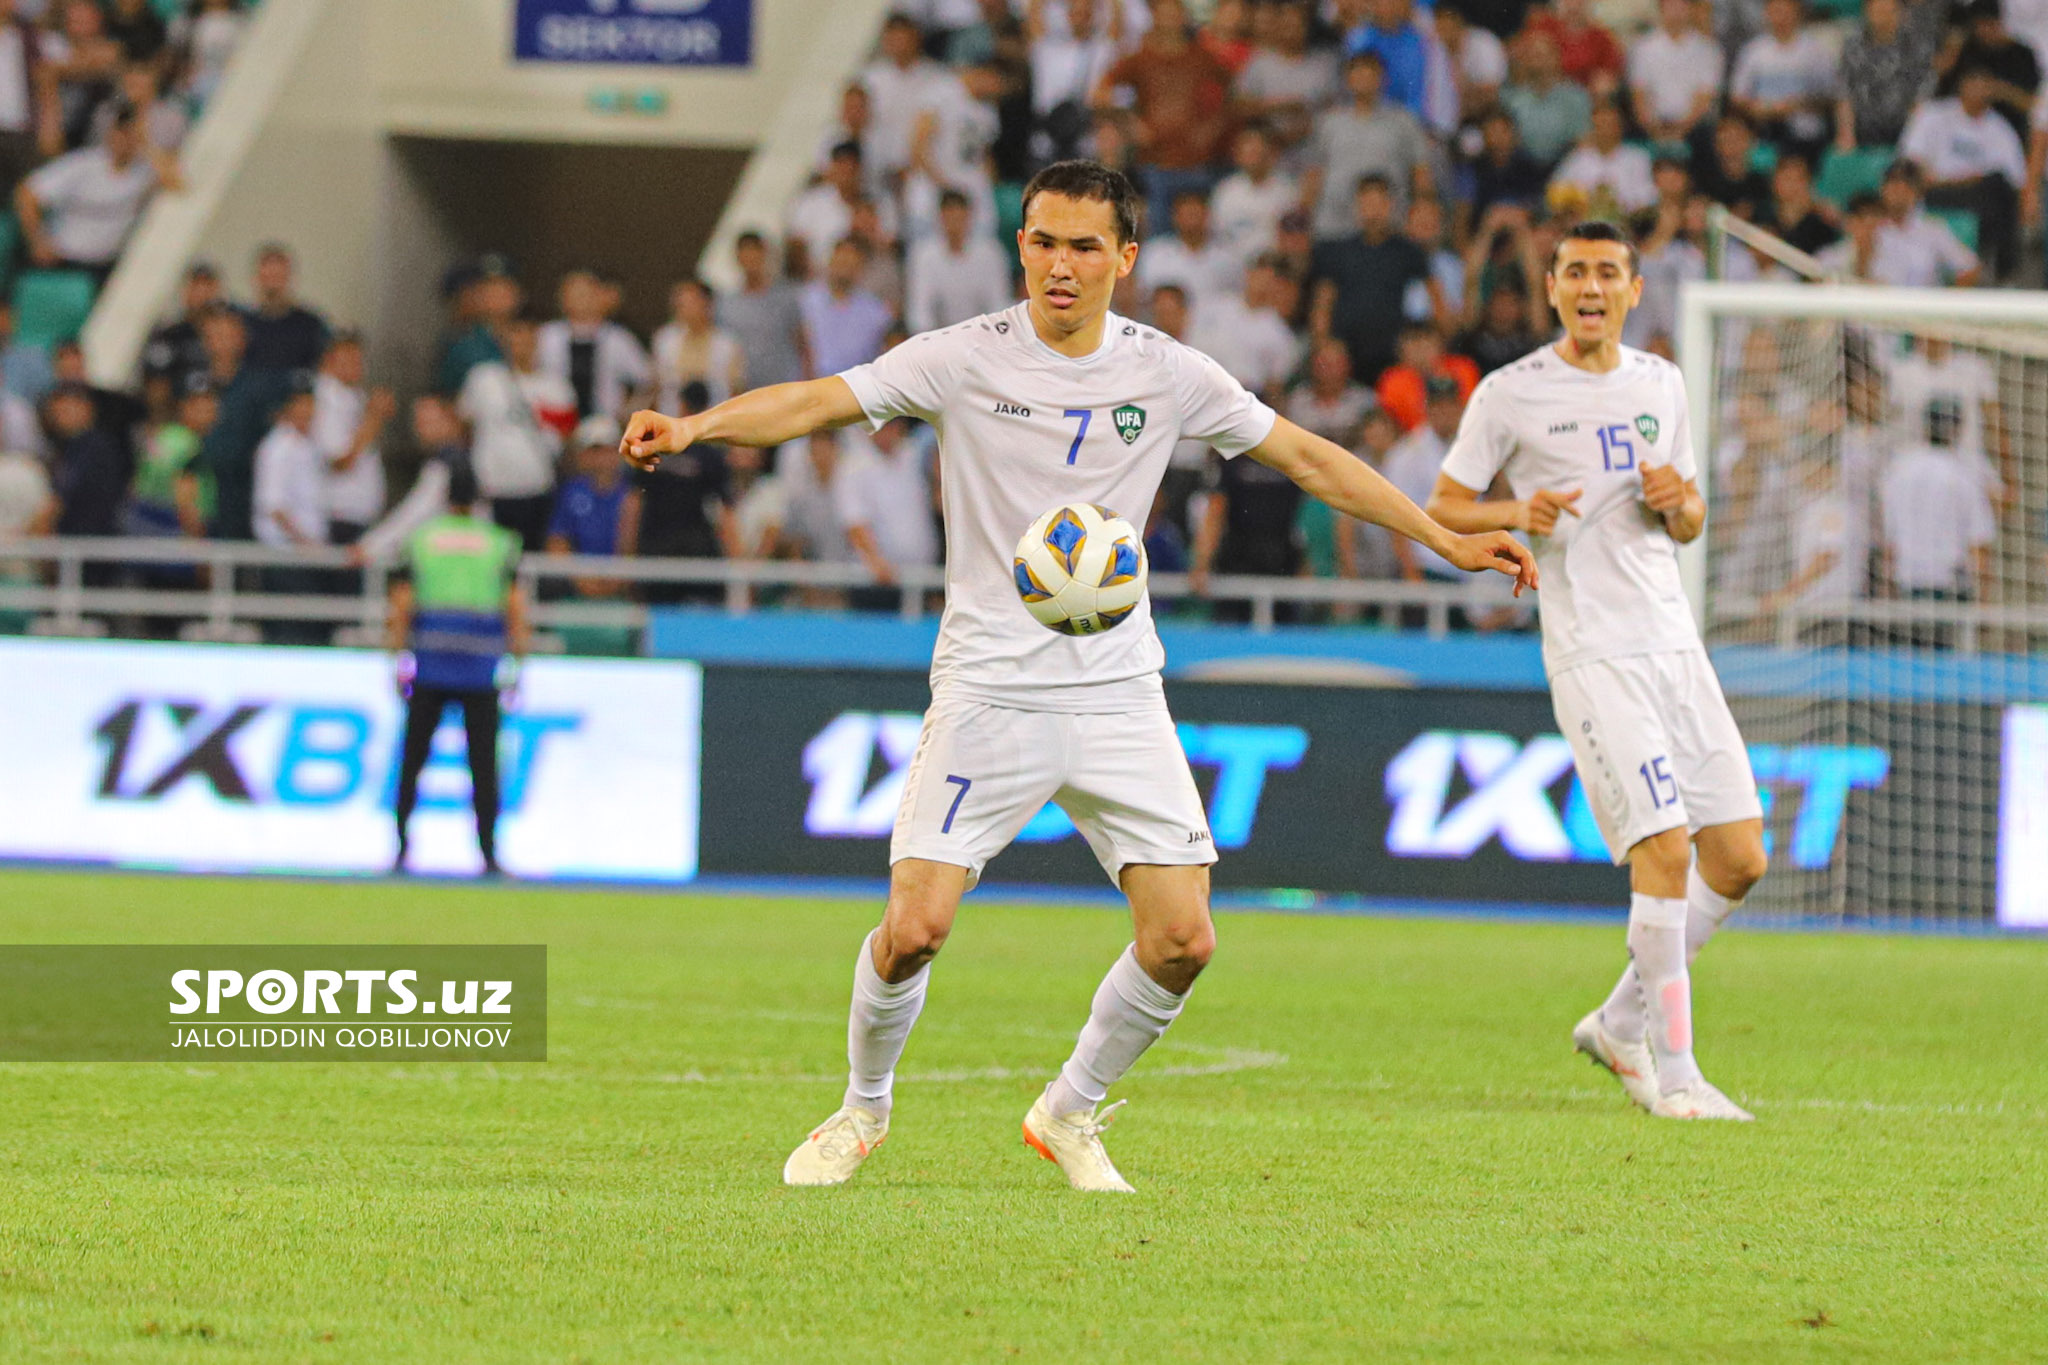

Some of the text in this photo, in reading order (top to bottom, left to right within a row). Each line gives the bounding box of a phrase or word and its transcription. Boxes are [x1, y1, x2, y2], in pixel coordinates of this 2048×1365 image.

[994, 402, 1031, 418] JAKO
[1063, 409, 1093, 466] 7
[1116, 411, 1142, 427] UFA
[1596, 424, 1635, 472] 15
[941, 774, 972, 835] 7
[1383, 730, 1891, 870] 1XT
[1640, 755, 1678, 810] 15
